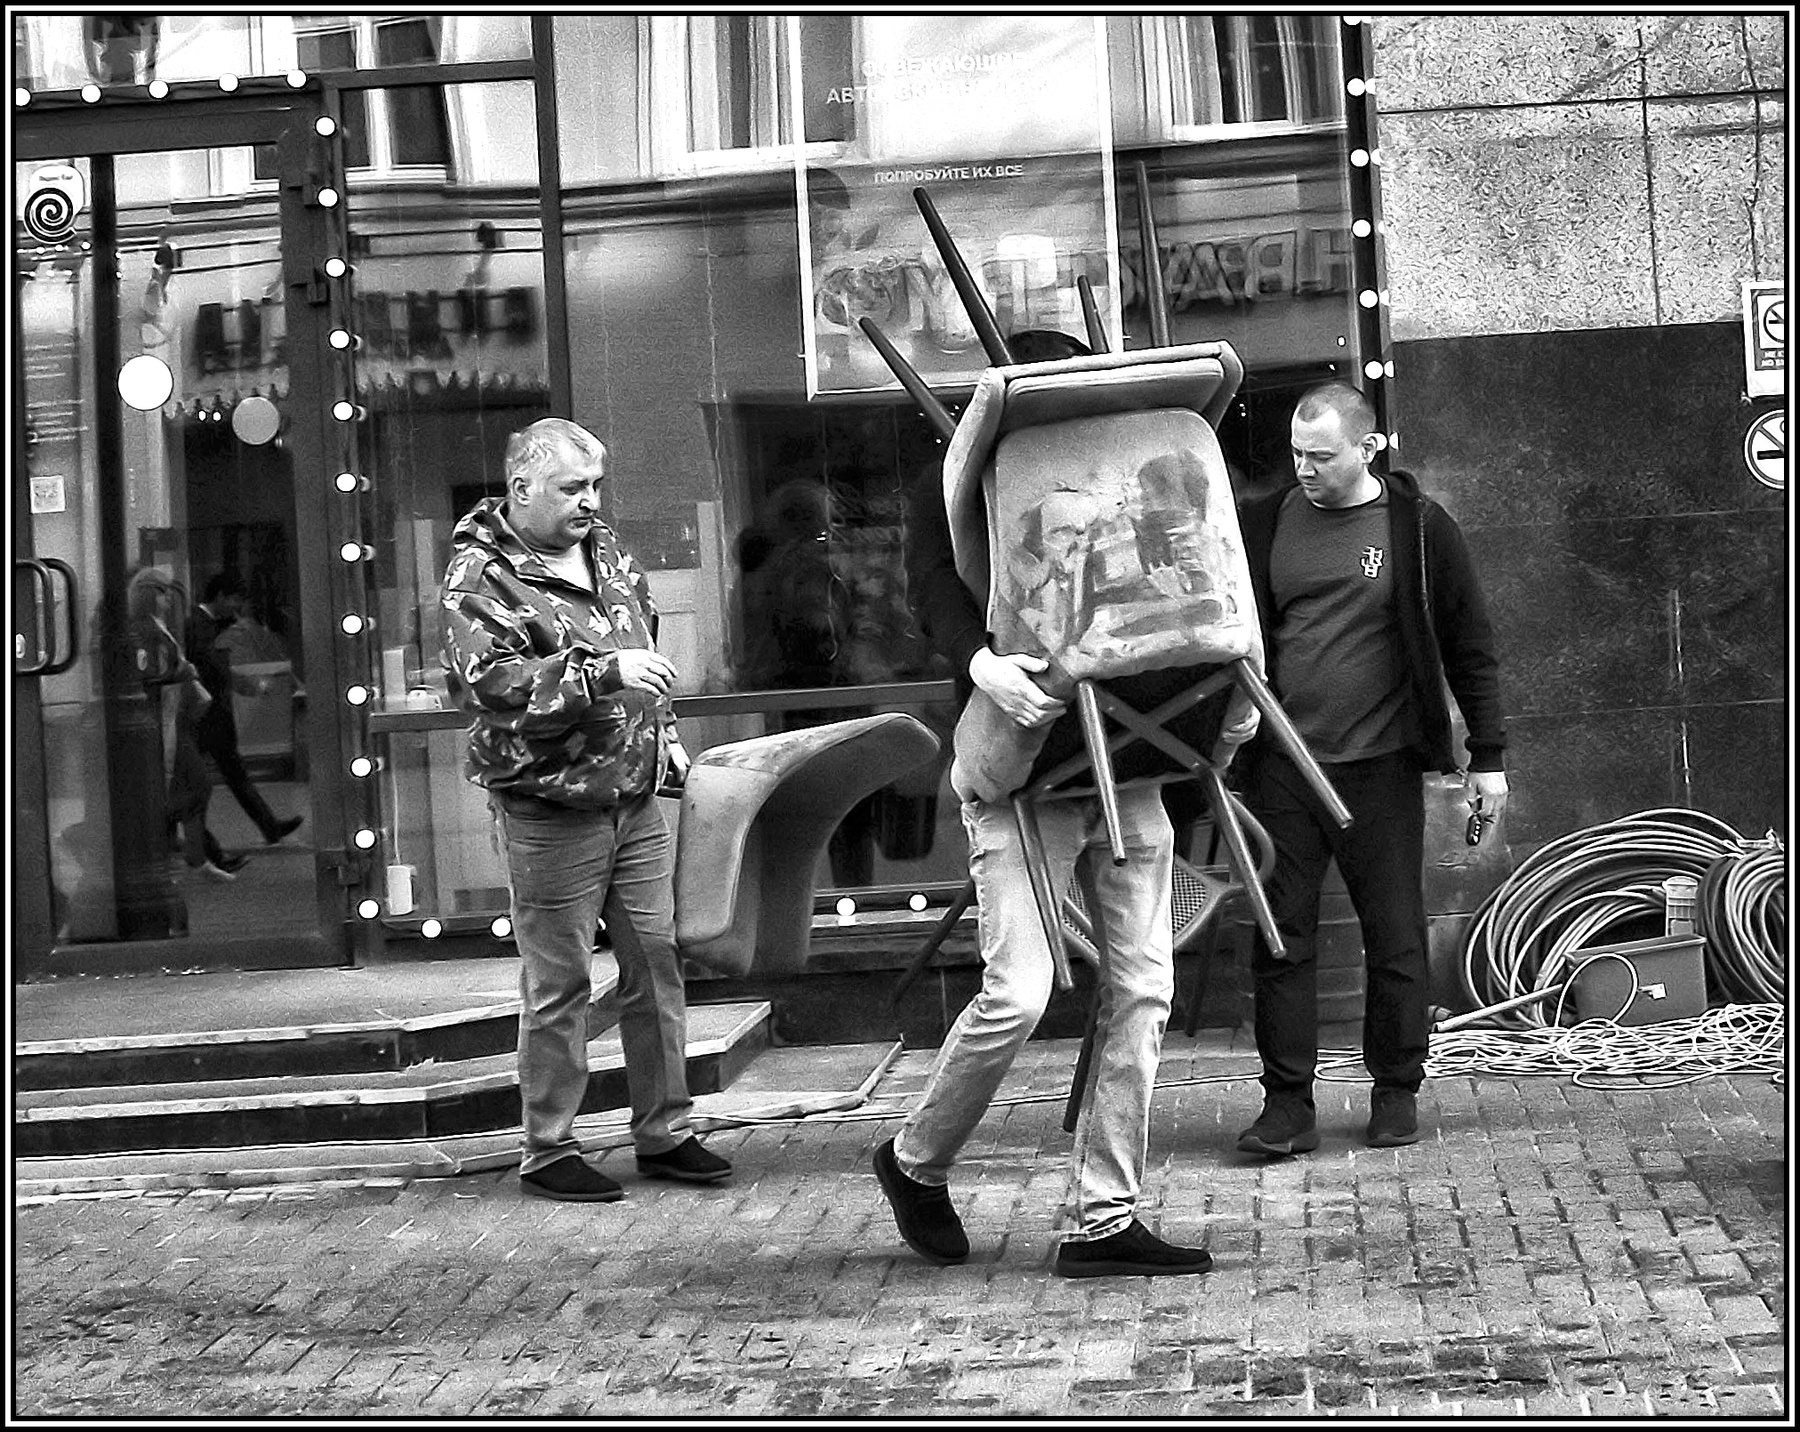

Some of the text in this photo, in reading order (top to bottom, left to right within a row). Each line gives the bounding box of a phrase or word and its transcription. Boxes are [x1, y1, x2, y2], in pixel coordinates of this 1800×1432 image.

[875, 165, 1023, 183] ПОПРОБУЙТЕ ИХ ВСЕ
